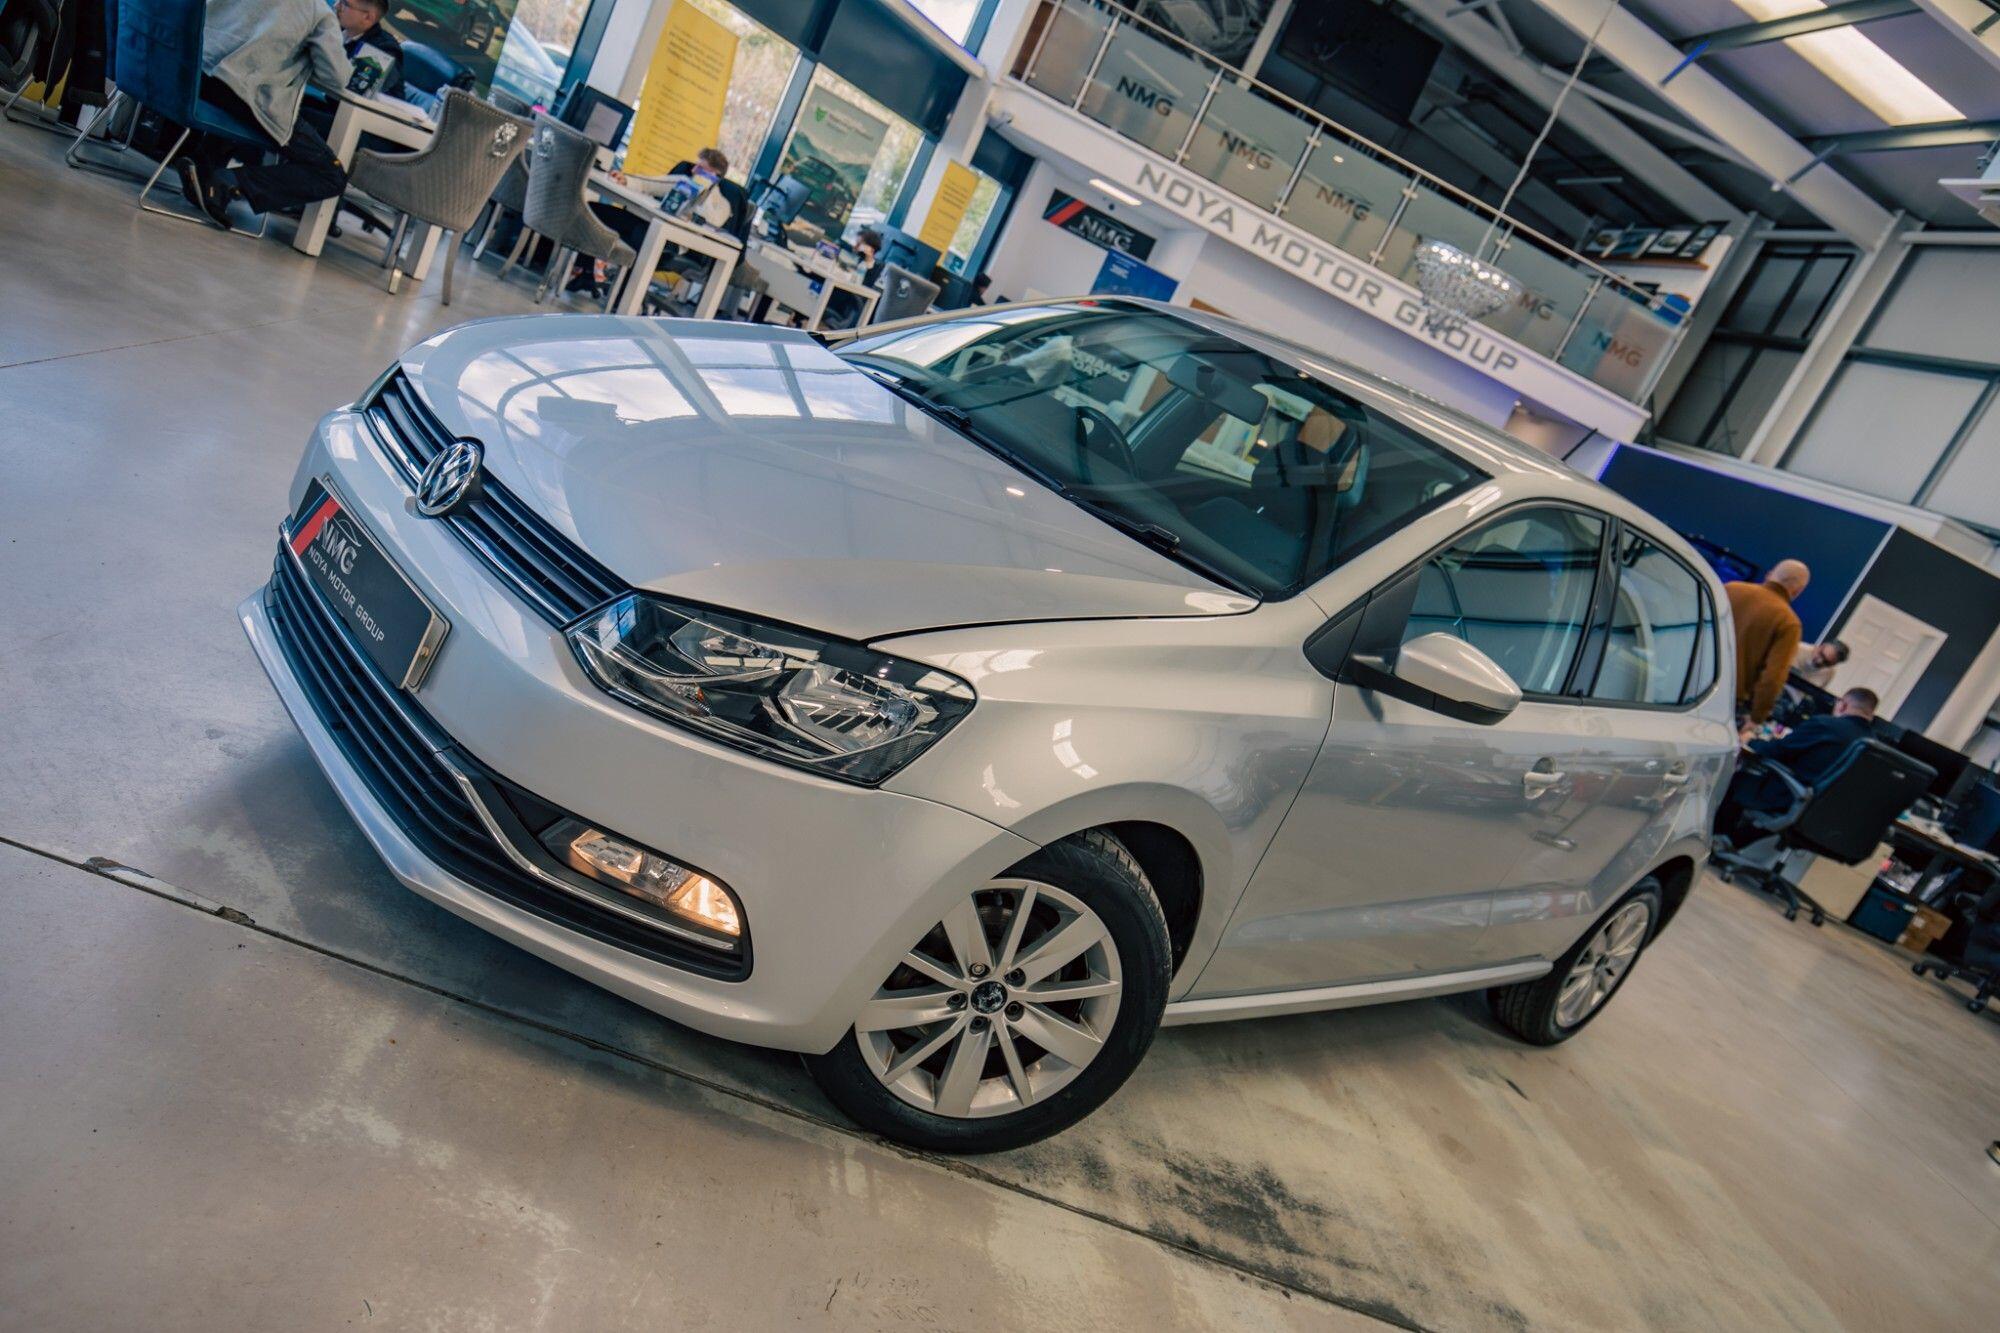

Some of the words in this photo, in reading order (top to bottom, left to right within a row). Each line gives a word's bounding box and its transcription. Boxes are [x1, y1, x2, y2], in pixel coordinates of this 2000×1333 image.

[1116, 75, 1173, 117] NMG
[1218, 130, 1273, 169] NMG
[1316, 186, 1371, 221] NMG
[1080, 214, 1132, 250] NMG
[1136, 163, 1235, 233] NOYA
[1251, 224, 1383, 308] MOTOR
[1592, 331, 1645, 368] NMG
[315, 516, 358, 575] NMG
[308, 545, 329, 576] NOYA
[328, 570, 357, 609] MOTOR
[355, 604, 385, 642] GROUP
